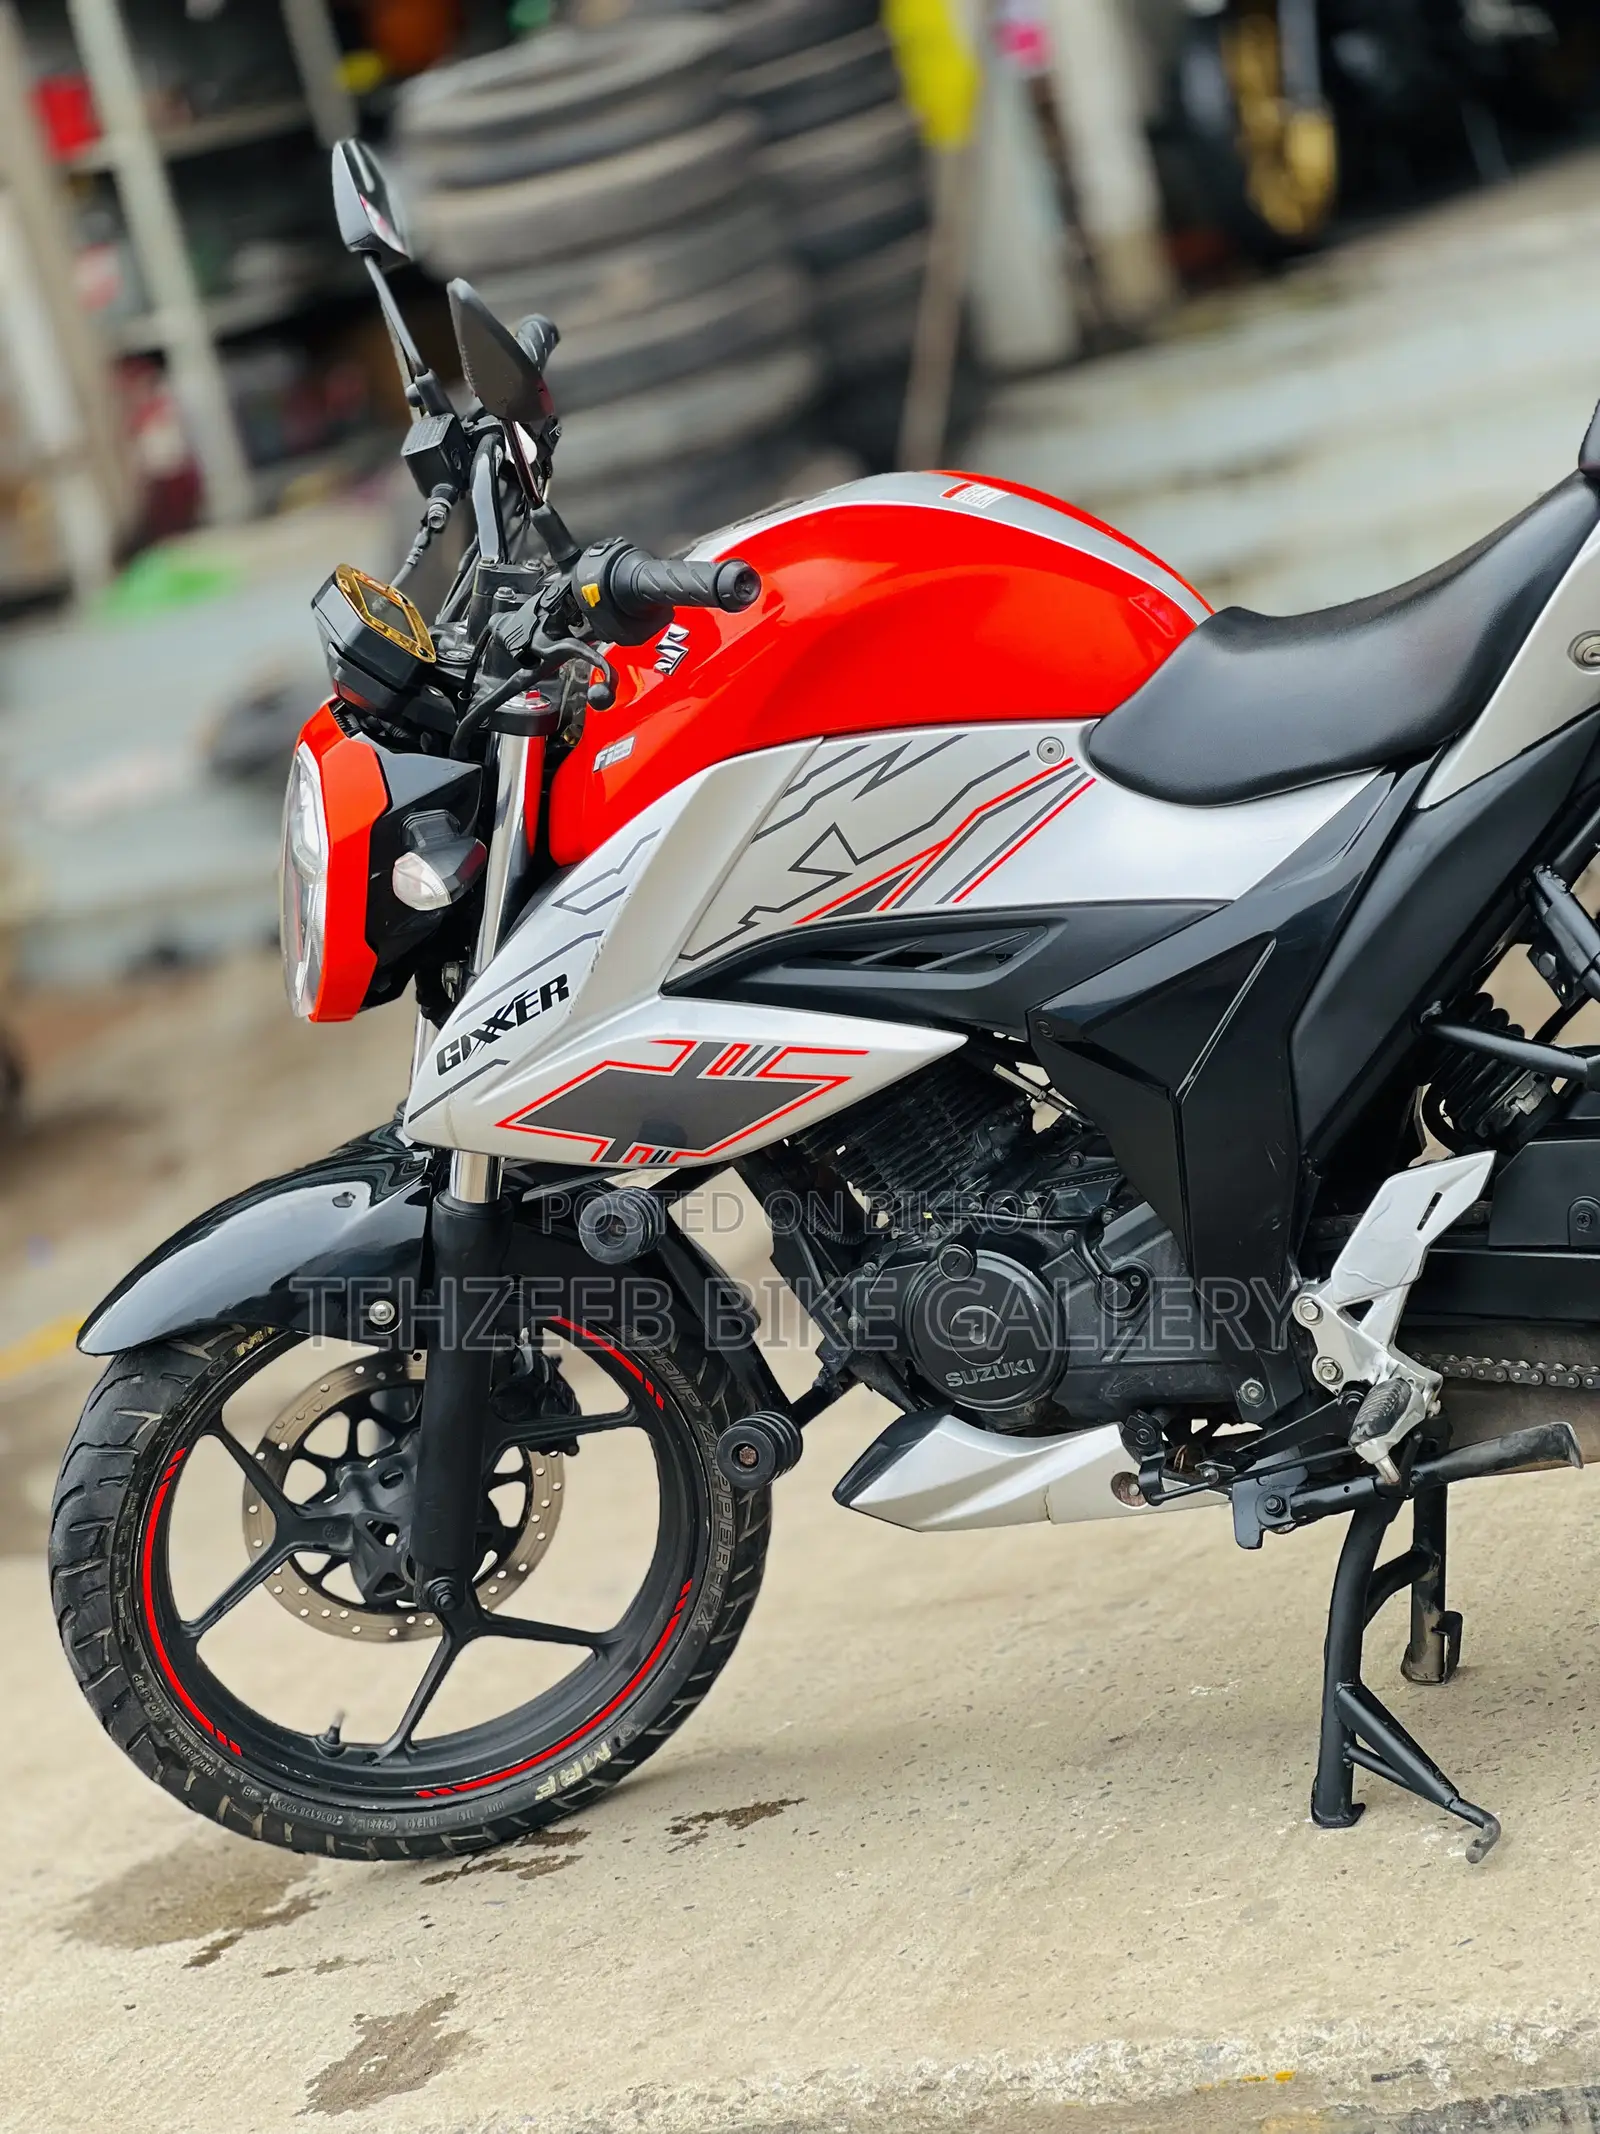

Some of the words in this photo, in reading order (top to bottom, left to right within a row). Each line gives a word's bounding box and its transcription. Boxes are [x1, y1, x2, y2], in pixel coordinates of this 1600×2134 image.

[436, 973, 570, 1076] GIXXER
[945, 1358, 1036, 1387] SUZUKI
[534, 1741, 612, 1801] MRF
